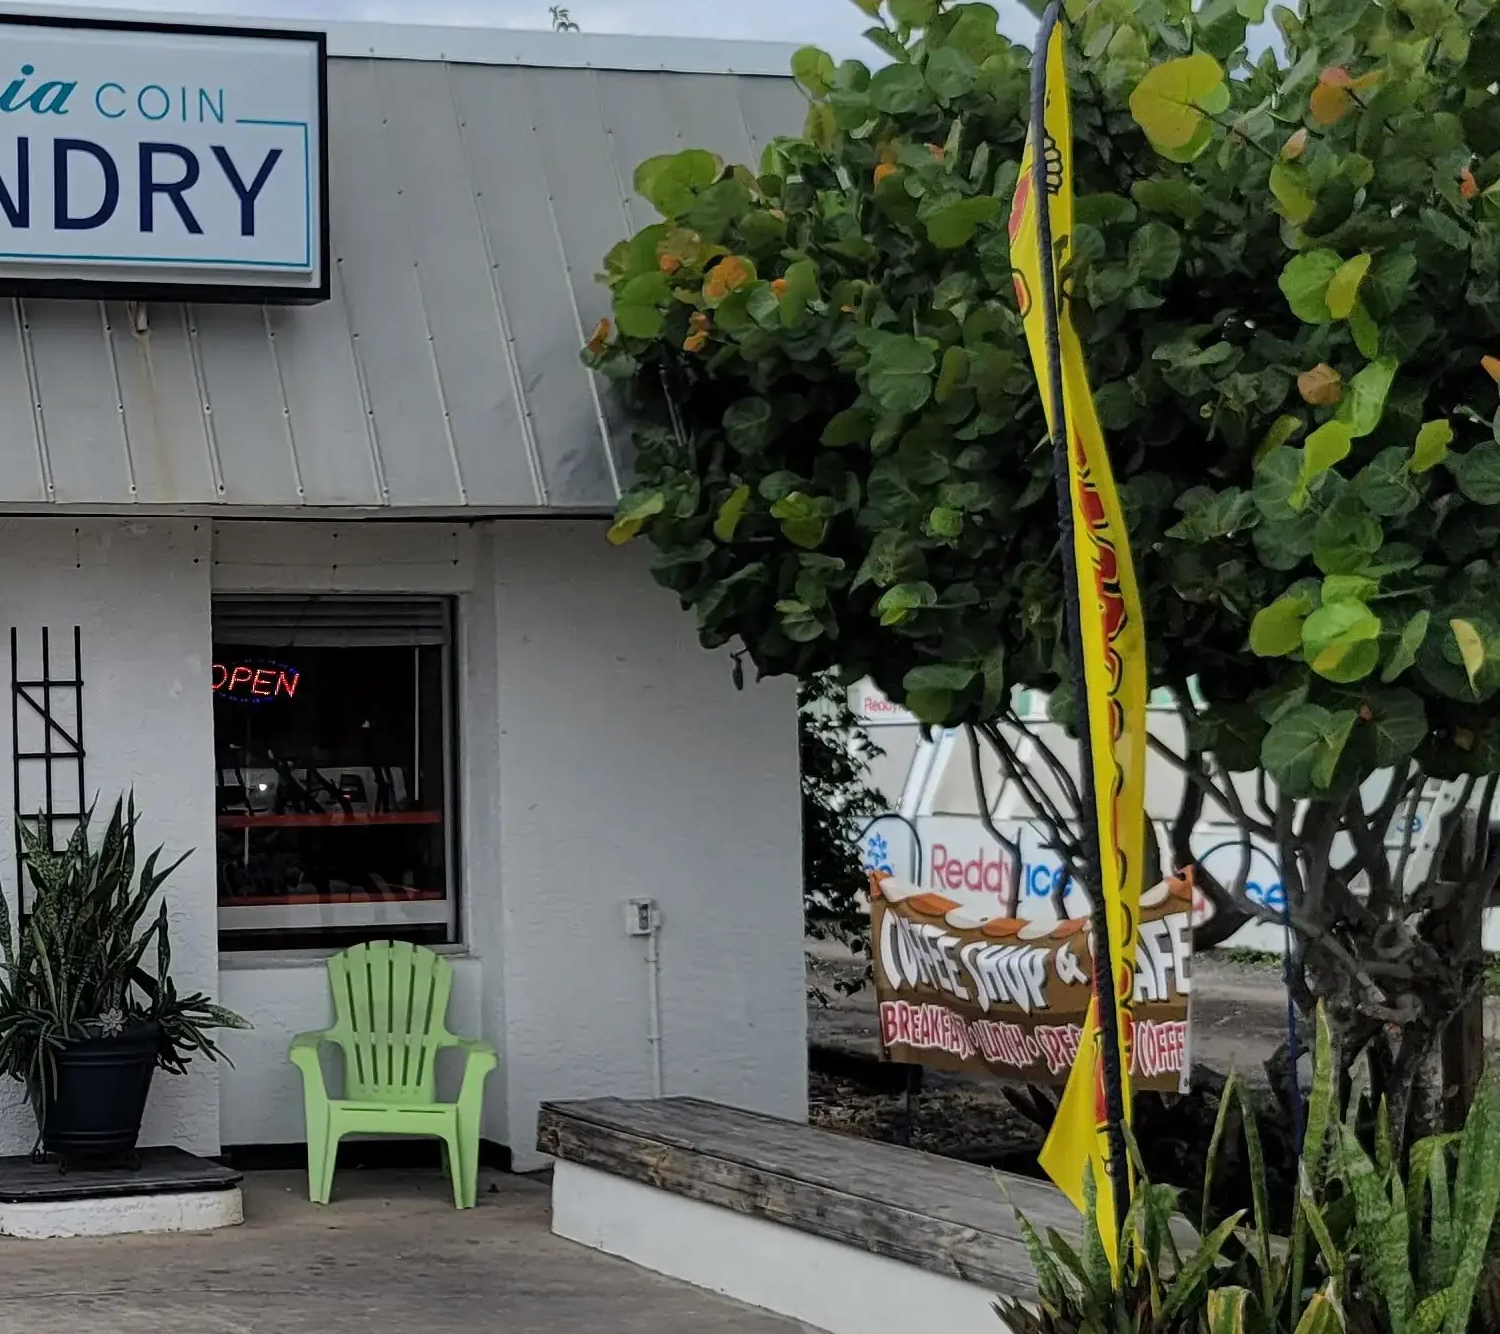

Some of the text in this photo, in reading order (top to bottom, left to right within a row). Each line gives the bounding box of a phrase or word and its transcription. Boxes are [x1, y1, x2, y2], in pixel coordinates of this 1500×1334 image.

[95, 82, 225, 124] COIN
[211, 664, 300, 698] OPEN
[931, 844, 1012, 906] Reddy
[959, 940, 1051, 1014] SHOP
